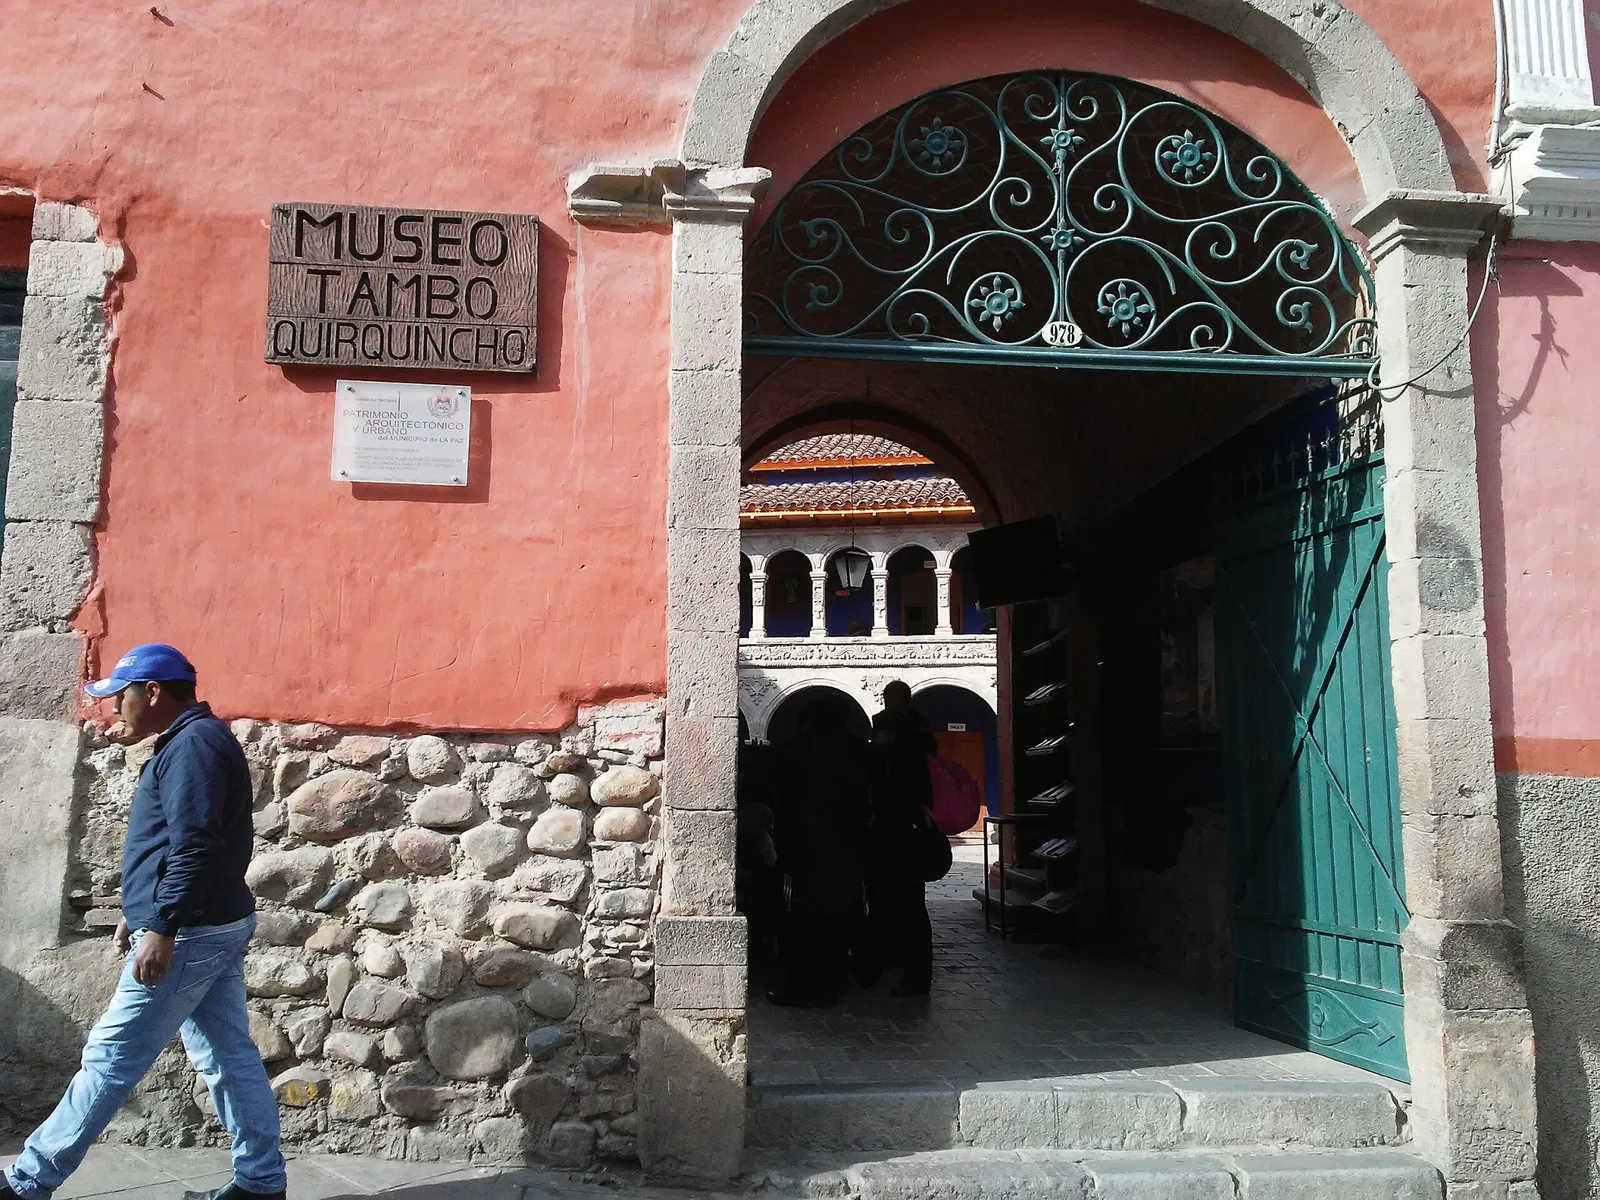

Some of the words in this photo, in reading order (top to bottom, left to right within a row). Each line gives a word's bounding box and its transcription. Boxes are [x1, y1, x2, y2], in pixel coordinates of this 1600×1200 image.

[295, 209, 509, 267] MUSEO
[306, 269, 499, 321] TAMBO
[272, 320, 527, 366] QUIRQUINCHO
[1049, 323, 1075, 344] 978
[343, 410, 409, 420] PATRIMONIO
[353, 425, 359, 433] Y
[362, 426, 408, 436] URBANO
